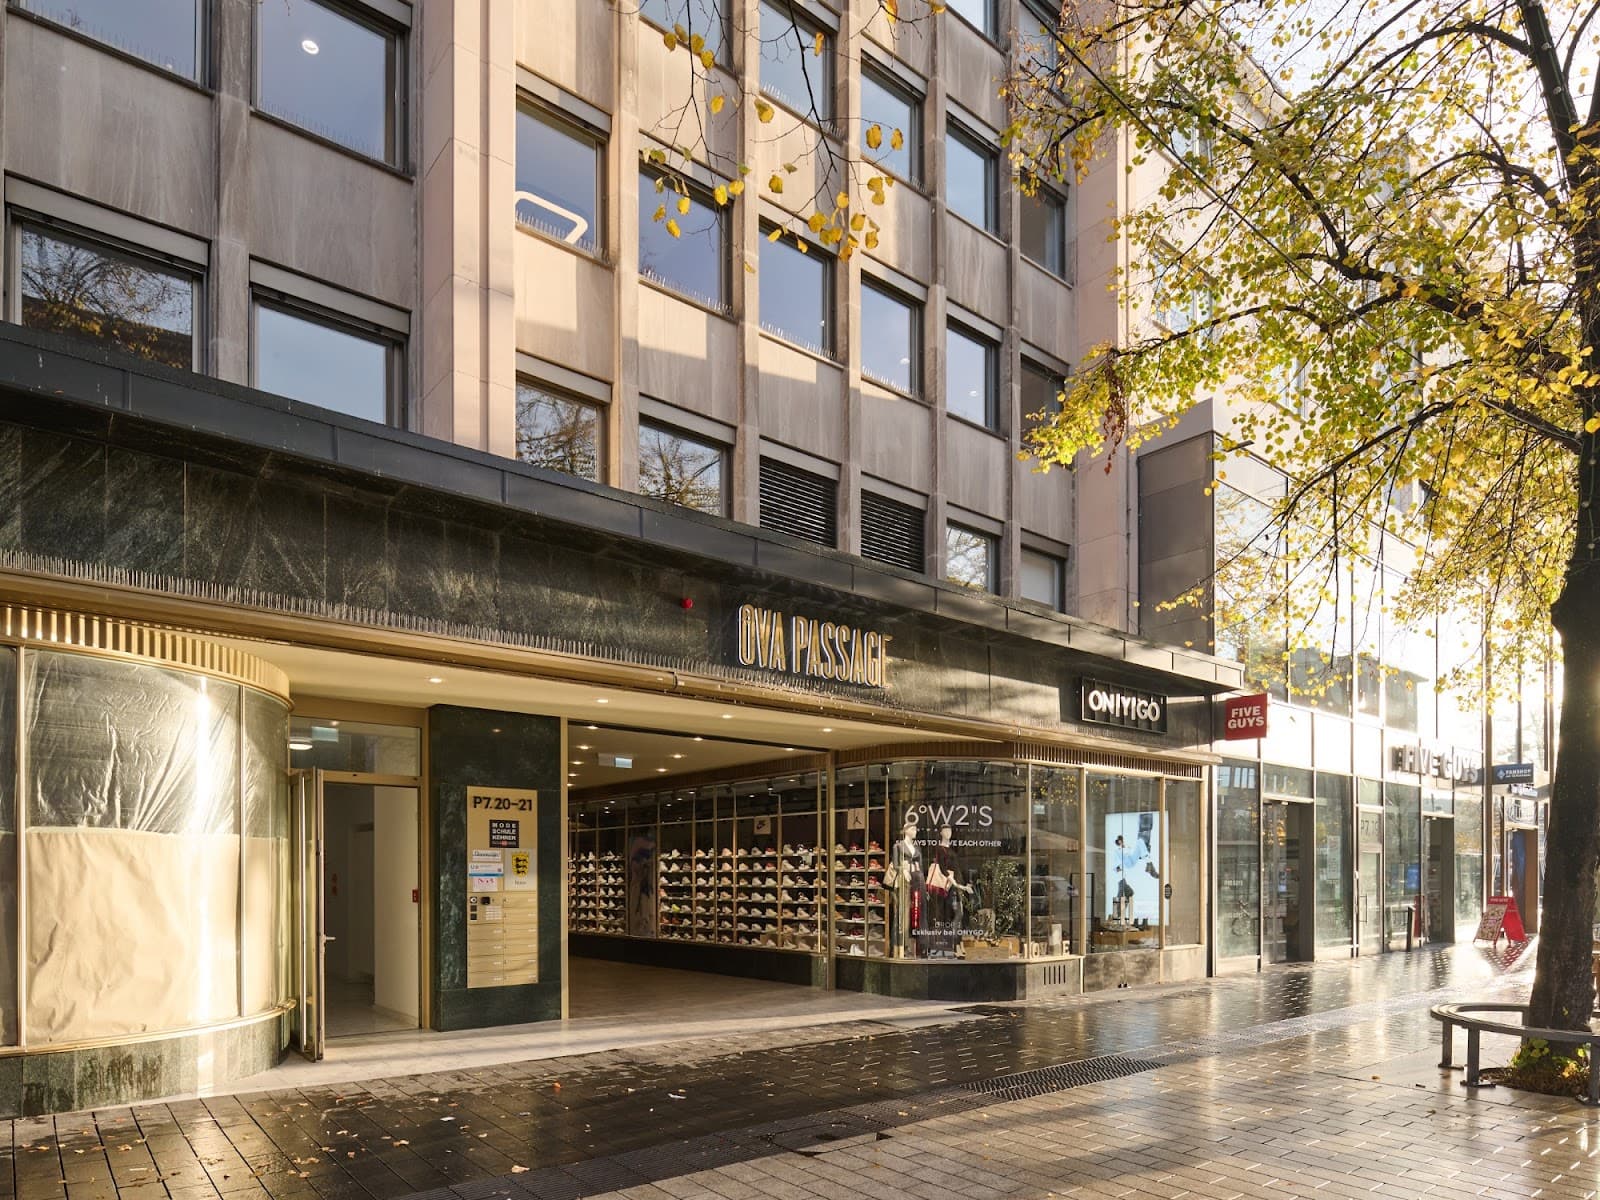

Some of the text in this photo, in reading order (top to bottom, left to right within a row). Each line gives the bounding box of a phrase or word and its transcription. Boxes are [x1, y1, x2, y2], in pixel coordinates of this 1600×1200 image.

[738, 603, 893, 689] OVA PASSAGE
[1231, 705, 1261, 718] FIVE
[1227, 716, 1265, 730] GUYS
[938, 839, 958, 847] LVE
[958, 839, 978, 847] EACH
[978, 839, 1002, 847] OTHER
